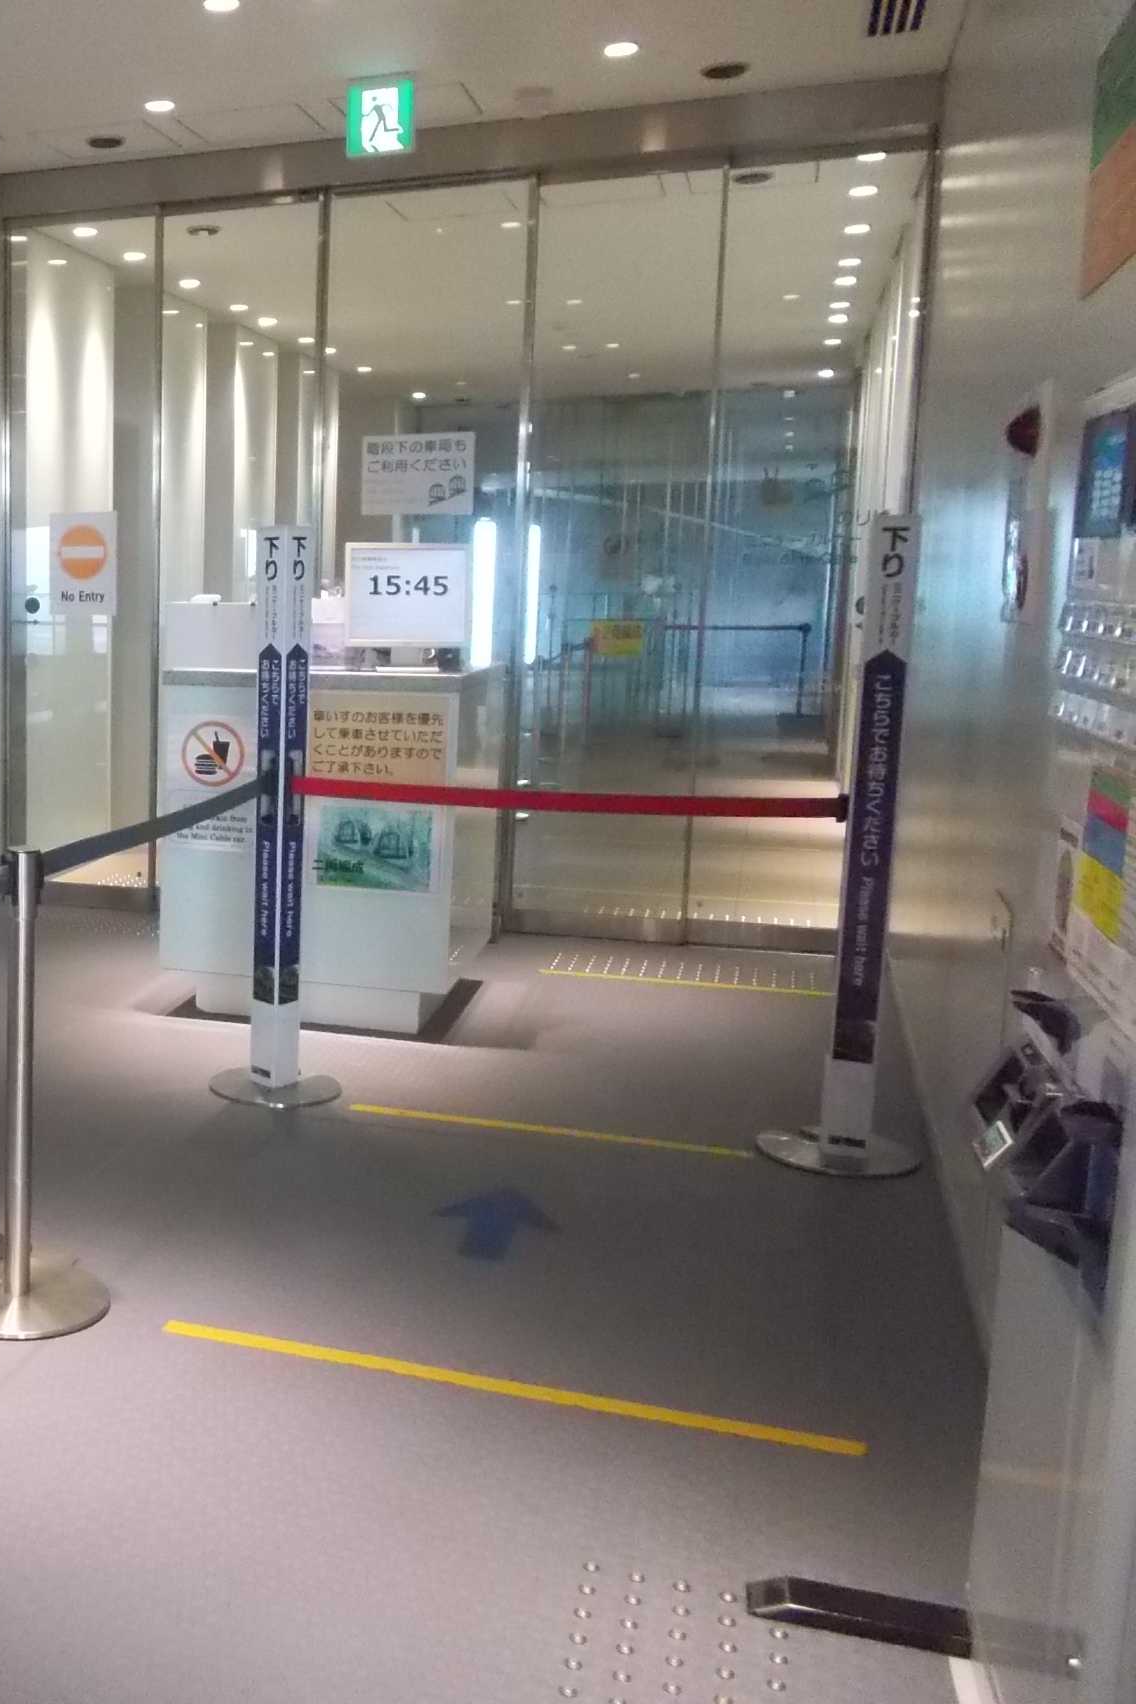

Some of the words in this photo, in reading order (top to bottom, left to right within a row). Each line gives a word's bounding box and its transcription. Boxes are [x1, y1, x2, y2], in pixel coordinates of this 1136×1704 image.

[367, 459, 466, 473] ご利用ください
[264, 536, 280, 581] 下り
[292, 536, 307, 581] 下り
[881, 526, 910, 578] 下り
[369, 574, 449, 596] 15:45
[60, 591, 75, 602] No
[79, 590, 105, 604] Entry
[314, 744, 443, 760] くことがありますので
